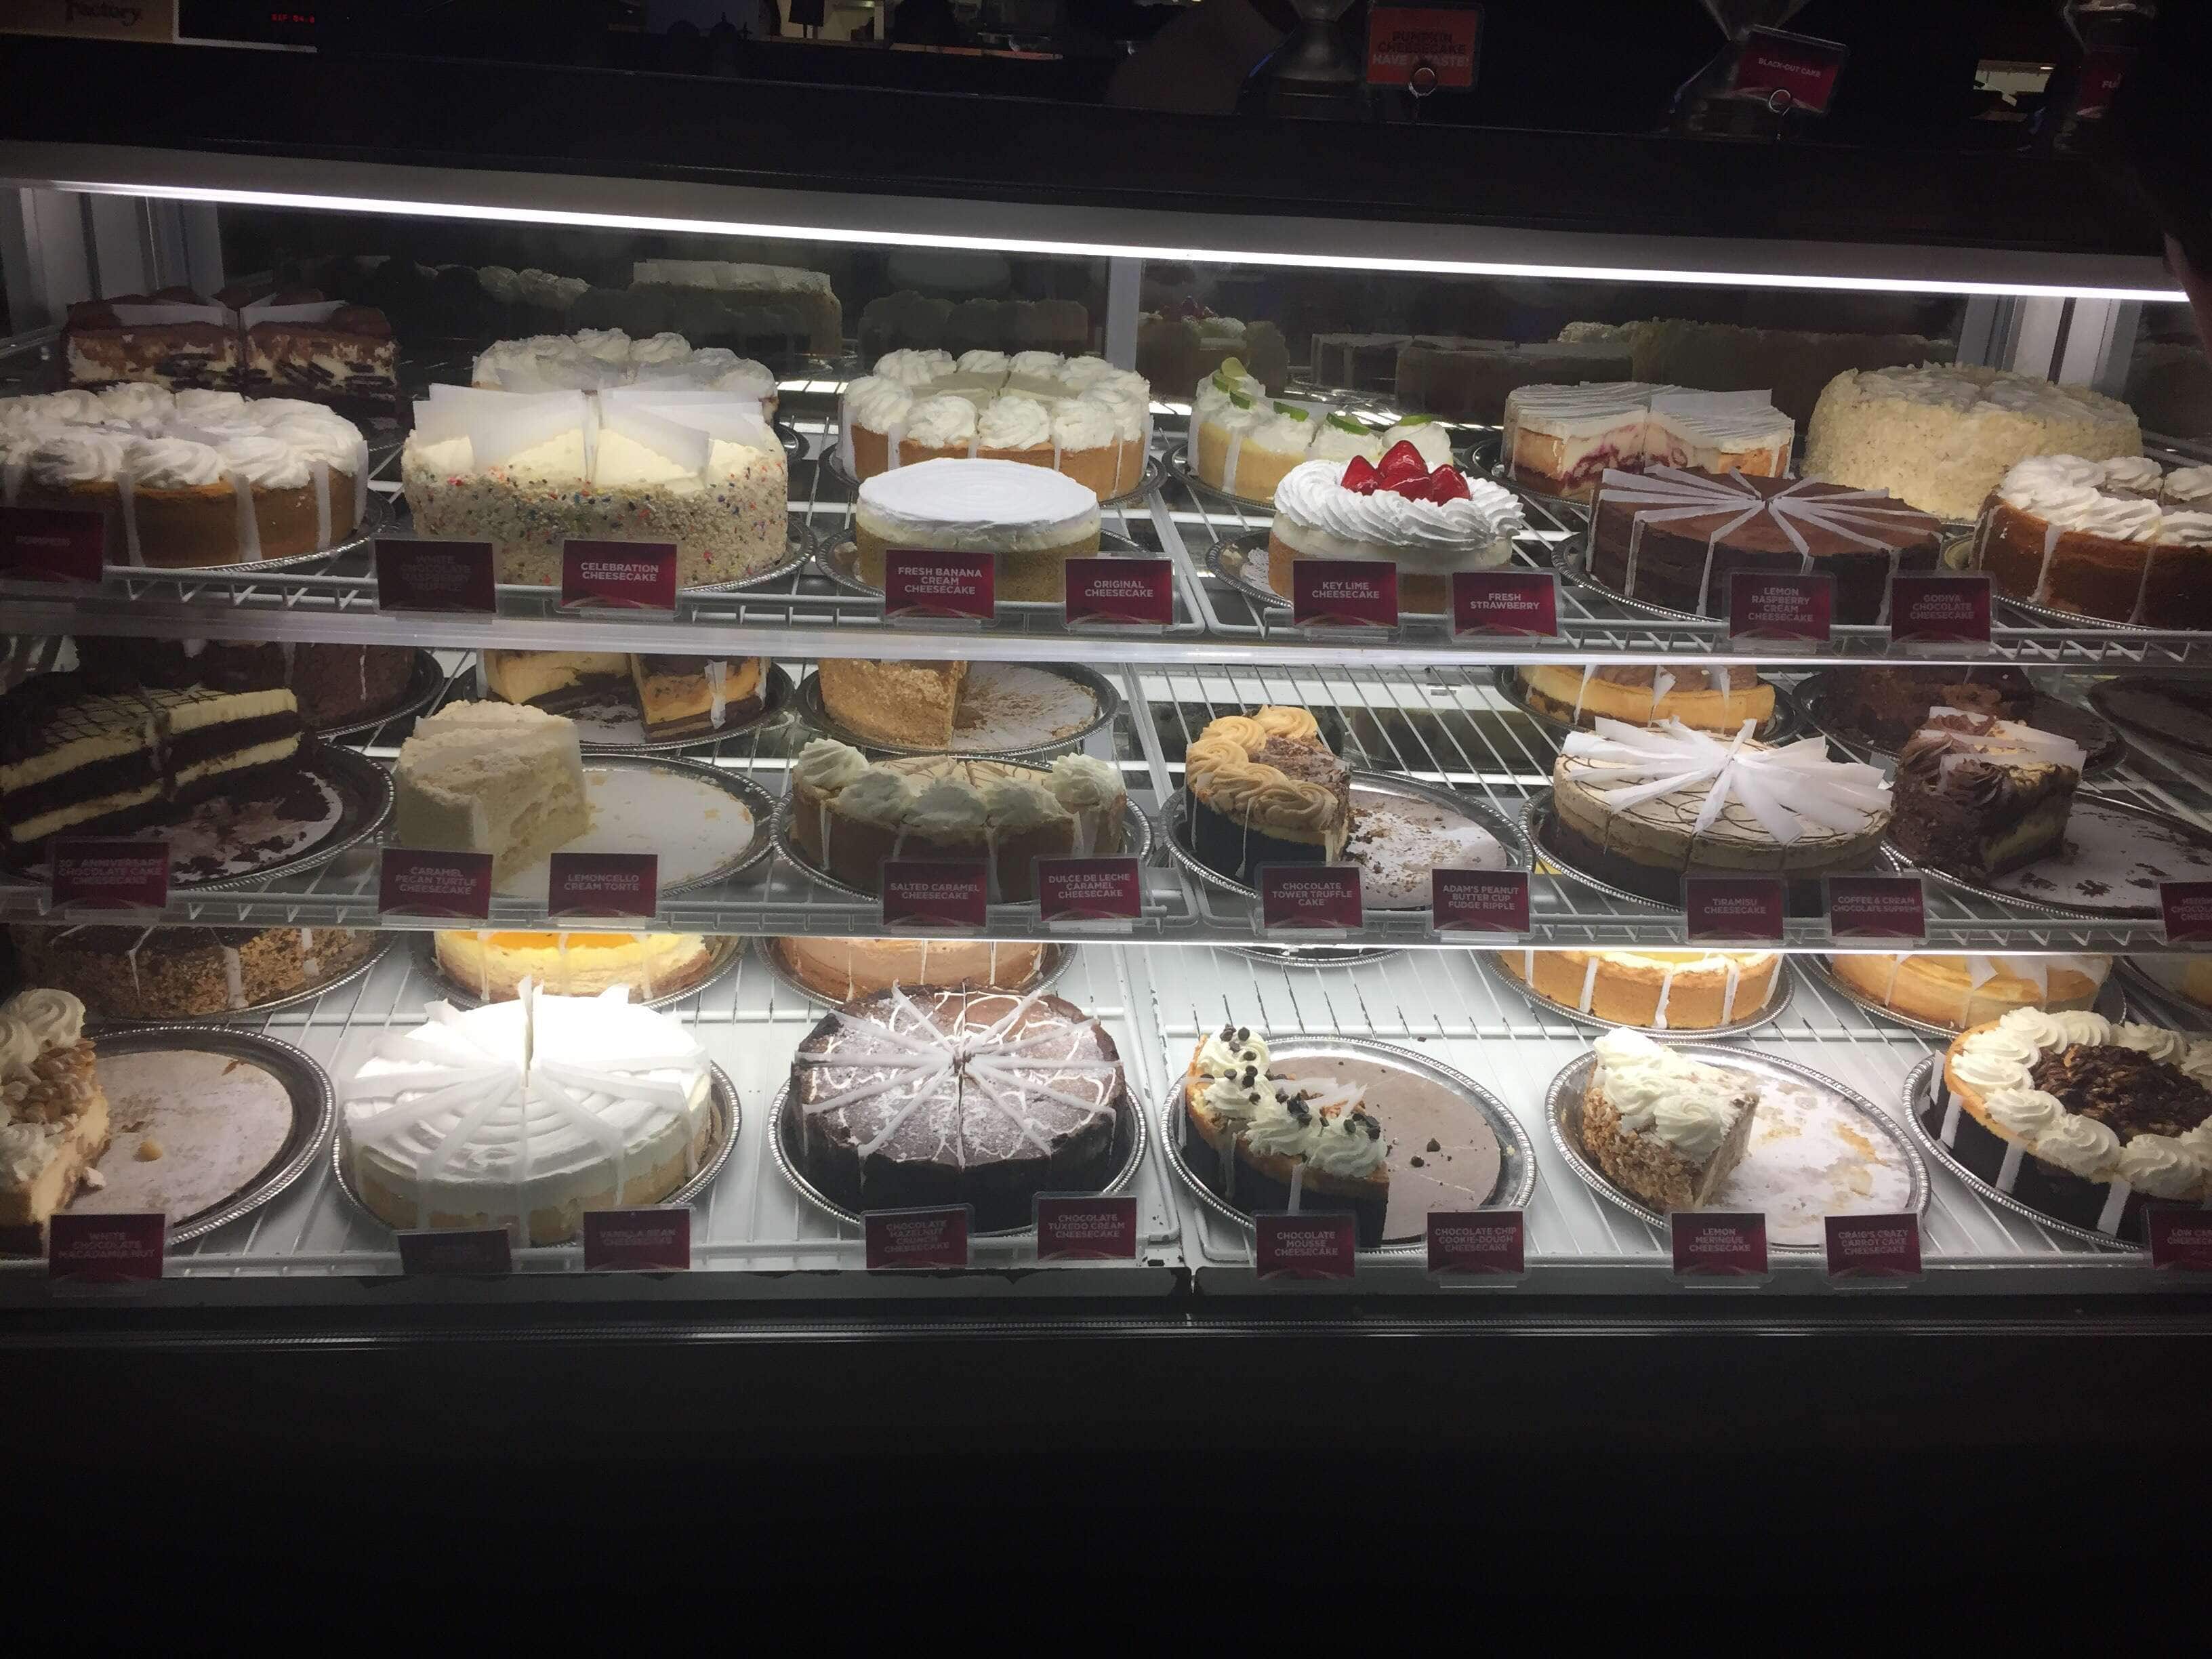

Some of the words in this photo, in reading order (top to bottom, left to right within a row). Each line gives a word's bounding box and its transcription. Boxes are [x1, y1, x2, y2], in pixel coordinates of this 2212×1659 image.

[1393, 31, 1453, 43] PUMPKIN
[1378, 43, 1466, 54] CHEESECAKE
[1373, 54, 1407, 65] HAVE
[1801, 67, 1822, 78] CAKE
[581, 562, 659, 573] CELEBRATION
[898, 567, 933, 576] FRESH
[935, 568, 983, 577] BANANA
[582, 571, 657, 581] CHEESECAKE
[921, 576, 959, 585] CREAM
[1094, 580, 1145, 589] ORIGINAL
[1322, 581, 1345, 590] KEY
[1345, 581, 1370, 590] LIME
[904, 584, 976, 595] CHEESECAKE
[1085, 588, 1153, 598] CHEESECAKE
[1764, 588, 1799, 596] LEMON
[1312, 590, 1380, 599] CHEESECAKE
[1489, 593, 1521, 601] FRESH
[1923, 594, 1962, 602] GODIVA
[1752, 595, 1811, 605] RASPBERRY
[1470, 601, 1540, 610] STRAWBERRY
[1763, 604, 1799, 613] CREAM
[1912, 602, 1972, 611] CHOCOLATE
[1748, 612, 1814, 622] CHEESECAKE
[1910, 611, 1974, 619] CHEESECAKE
[58, 867, 126, 876] CHOCOLATE
[396, 874, 433, 884] PECAN
[436, 877, 477, 887] TURTLE
[568, 874, 640, 883] LEMONCELLO
[1048, 874, 1080, 884] DULCE
[1083, 874, 1097, 882] DE
[1099, 873, 1131, 882] LECHE
[400, 884, 472, 895] CHEESECAKE
[564, 882, 602, 890] CREAM
[604, 882, 640, 891] TORTE
[890, 883, 928, 891] SALTED
[931, 883, 981, 893] CARAMEL
[1066, 882, 1114, 890] CARAMEL
[1282, 882, 1342, 890] CHOCOLATE
[1443, 884, 1479, 893] ADAM'S
[1481, 886, 1519, 895] PEANUT
[901, 891, 969, 900] CHEESECAKE
[1058, 889, 1124, 899] CHEESECAKE
[1271, 890, 1308, 899] TOWER
[1311, 890, 1353, 899] TRUFFLE
[1452, 893, 1489, 902] BUTTER
[1492, 894, 1511, 903] CUP
[1298, 899, 1325, 907] CAKE
[1713, 898, 1757, 906] TIRAMISU
[1837, 896, 1872, 904] COFFEE
[1874, 896, 1881, 904] &
[1882, 896, 1914, 905] CREAM
[1448, 901, 1481, 909] FUDGE
[1483, 901, 1515, 910] RIPPLE
[1704, 906, 1767, 914] CHEESECAKE
[1058, 1214, 1118, 1223] CHOCOLATE
[886, 1220, 947, 1231] CHOCOLATE
[1091, 1222, 1125, 1230] CREAM
[890, 1227, 943, 1237] HAZELNUT
[1055, 1230, 1120, 1238] CHEESECAKE
[1277, 1231, 1336, 1240] CHOCOLATE
[1435, 1227, 1494, 1236] CHOCOLATE
[1495, 1227, 1517, 1235] CHIP
[1702, 1228, 1736, 1236] LEMON
[1839, 1231, 1875, 1239] CRAIG'S
[1877, 1229, 1909, 1238] CRAZY
[897, 1236, 938, 1245] CRUNCH
[1286, 1240, 1326, 1248] MOUSSE
[1695, 1236, 1744, 1244] MERINGUE
[1842, 1239, 1879, 1247] CARROT
[1882, 1237, 1907, 1246] CAKE
[884, 1242, 949, 1253] CHEESECAKE
[1274, 1248, 1339, 1256] CHEESECAKE
[1445, 1243, 1508, 1252] CHEESECAKE
[1689, 1244, 1752, 1252] CHEESECAKE
[1844, 1246, 1906, 1255] CHEESECAKE
